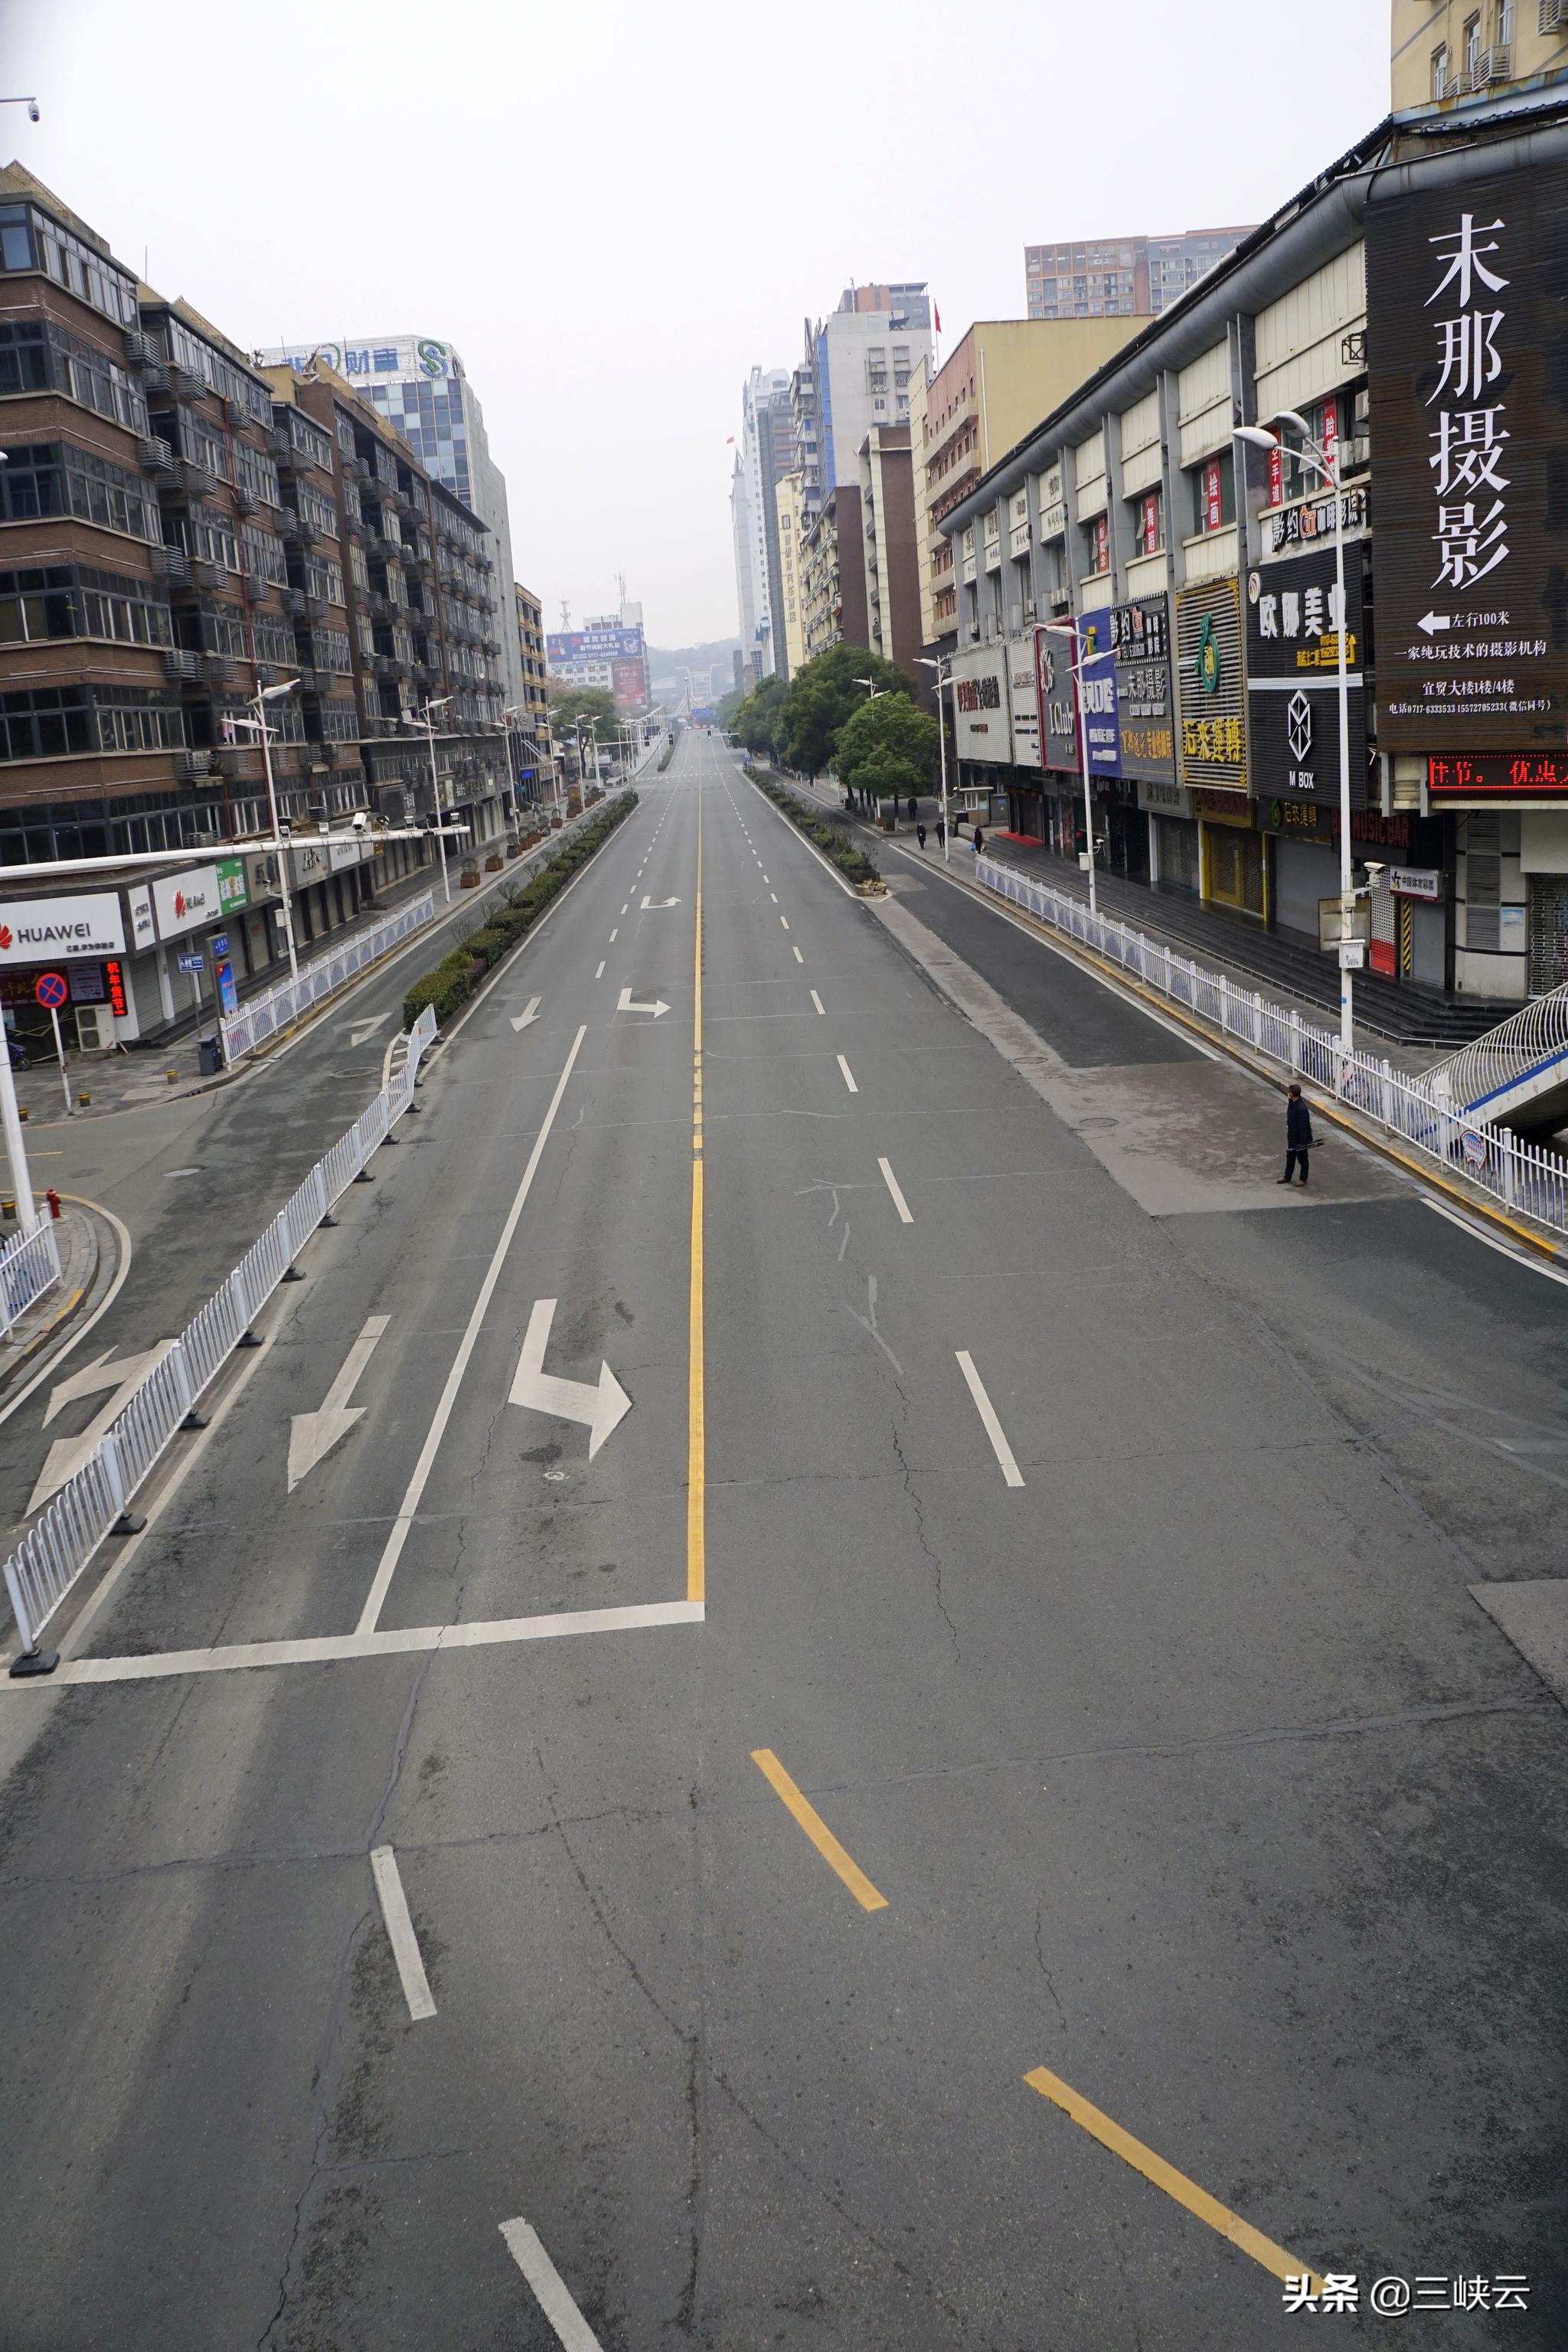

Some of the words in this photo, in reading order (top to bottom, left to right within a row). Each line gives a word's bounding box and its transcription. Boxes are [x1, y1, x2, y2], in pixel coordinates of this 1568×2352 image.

[1451, 610, 1510, 629] 左行100米
[1394, 639, 1547, 662] 一家纯玩技术的摄影机构
[1422, 678, 1515, 697] 宜贸大楼1楼/4楼
[1289, 770, 1296, 787] M
[1298, 771, 1315, 789] BOX
[1509, 760, 1567, 786] 优惠
[1402, 875, 1434, 890] 中国体育彩票
[18, 923, 91, 943] HUAWEI
